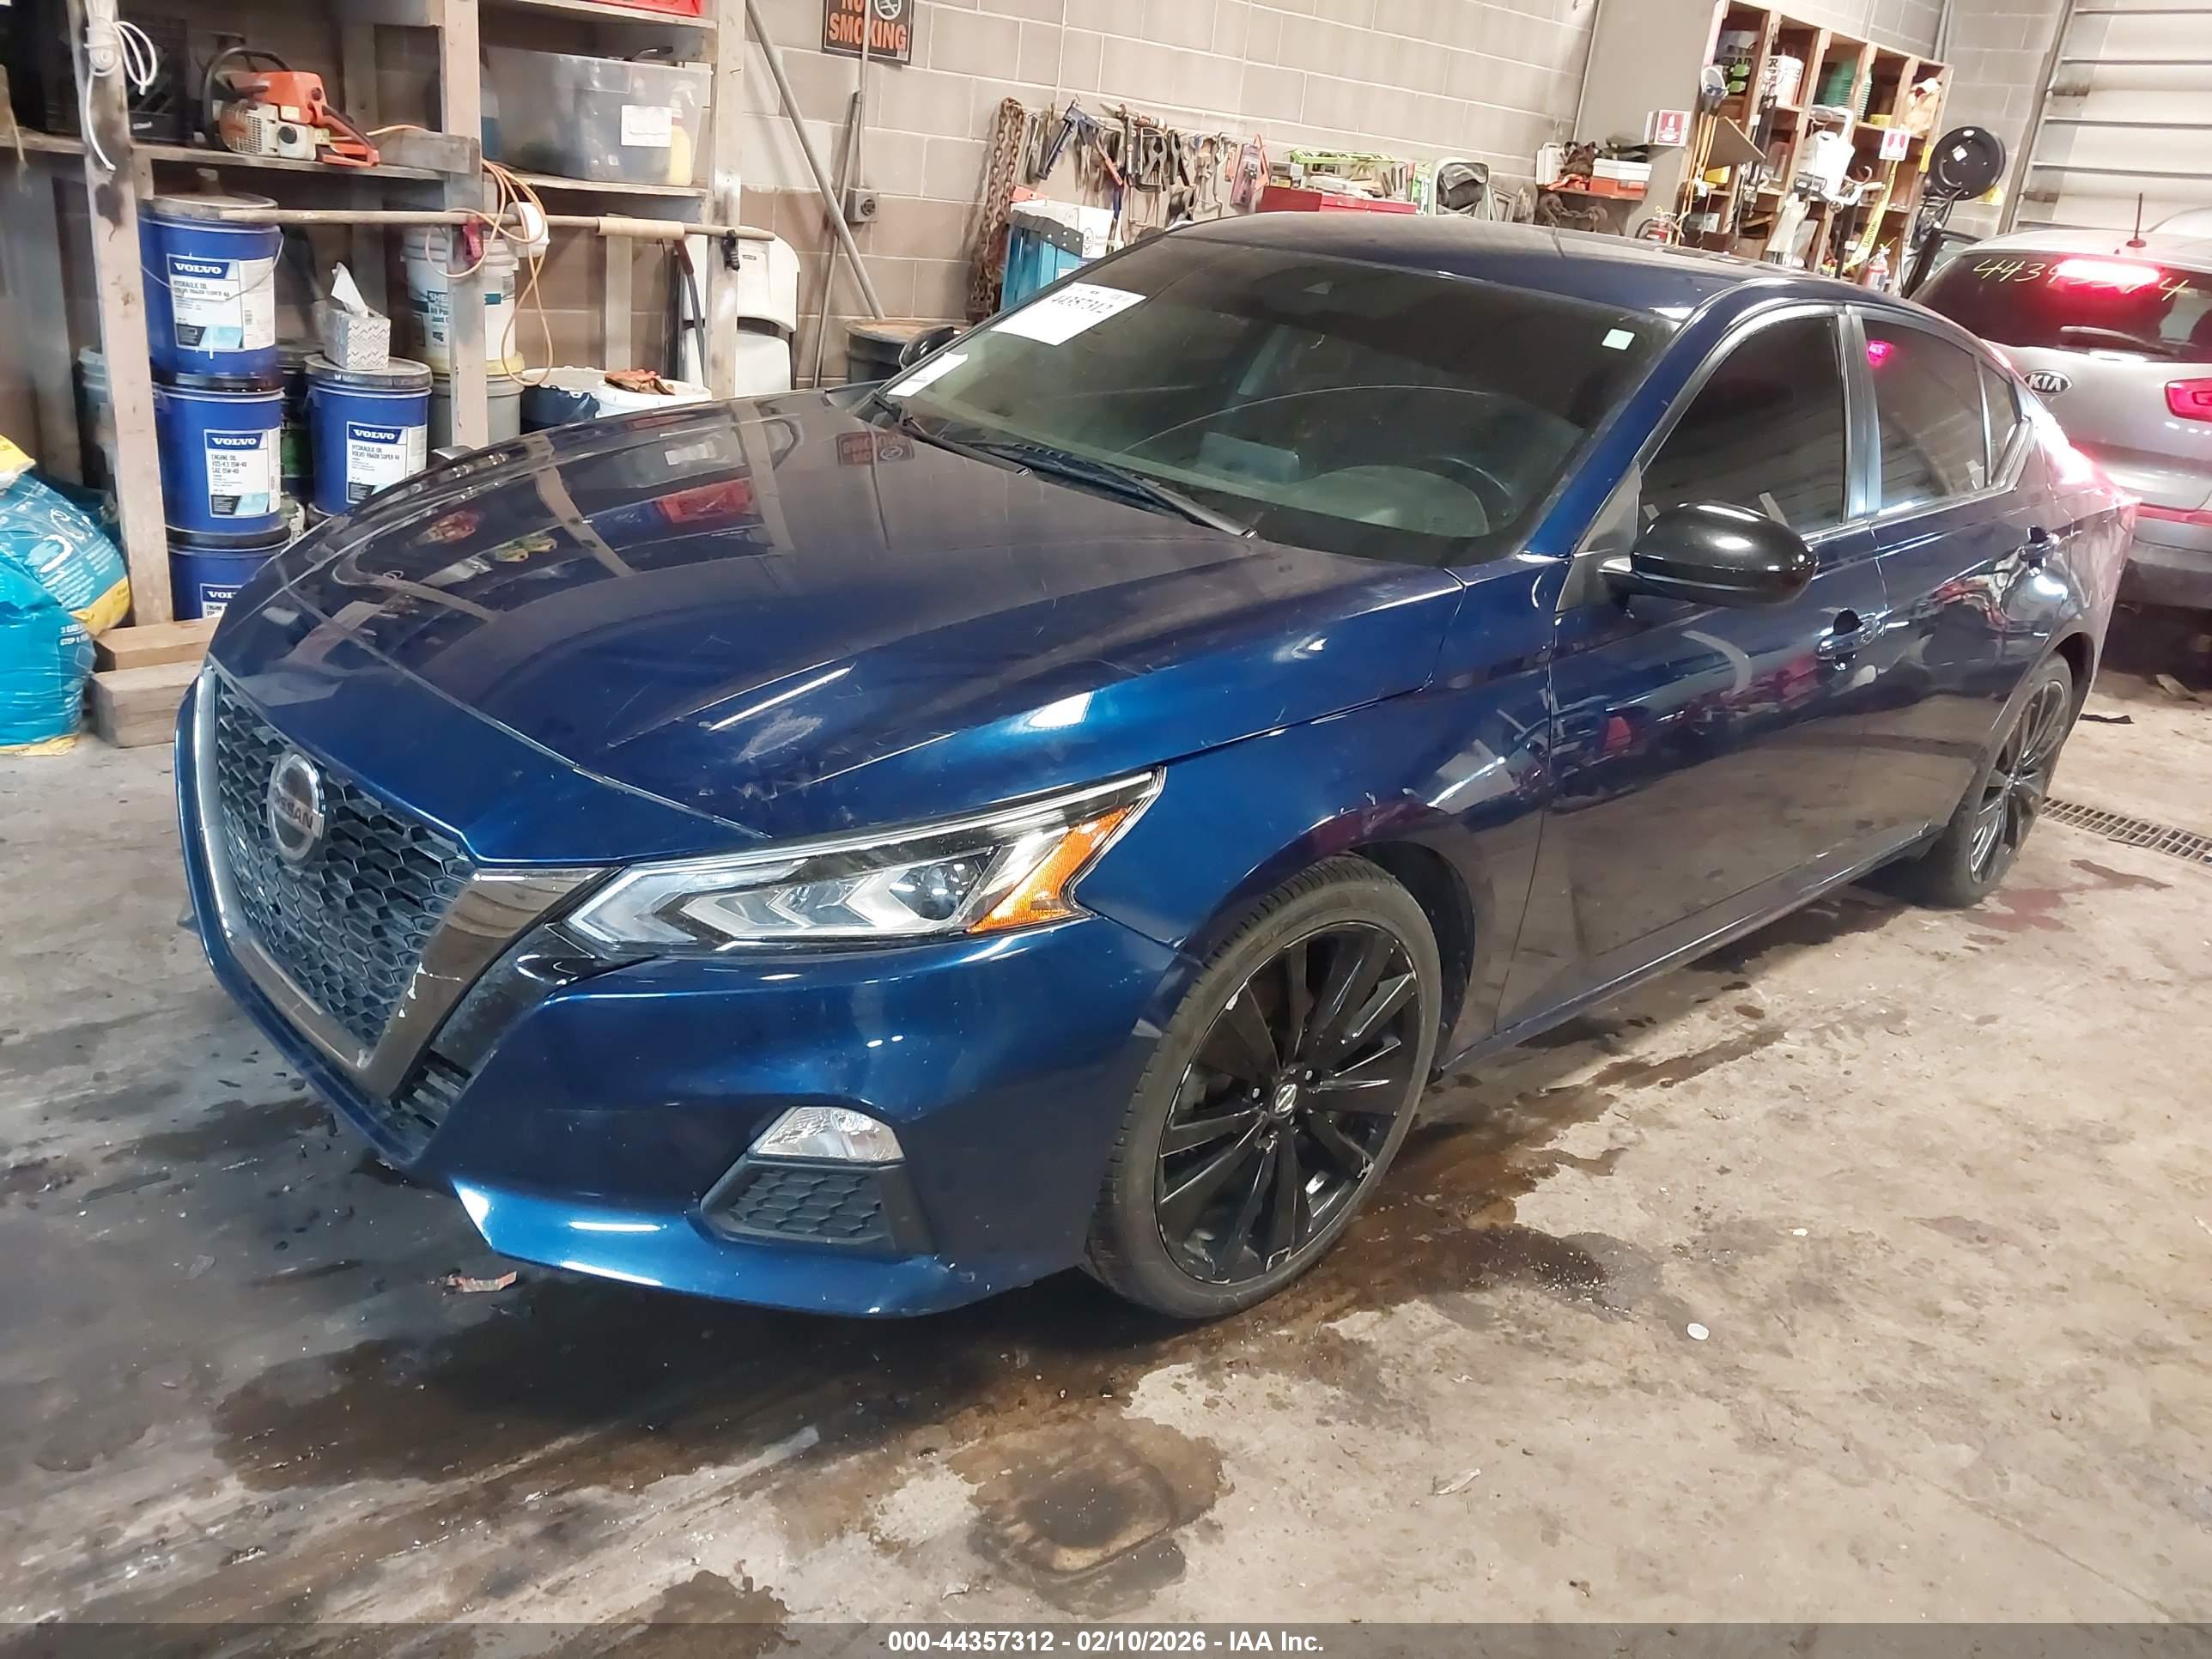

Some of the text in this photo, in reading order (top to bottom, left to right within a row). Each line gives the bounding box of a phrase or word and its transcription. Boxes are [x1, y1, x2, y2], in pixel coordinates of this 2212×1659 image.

[173, 262, 222, 275] VOLVO
[2028, 374, 2063, 392] KIA
[352, 428, 396, 440] VOLVO
[211, 437, 257, 446] VOLVO
[207, 590, 237, 599] VOL
